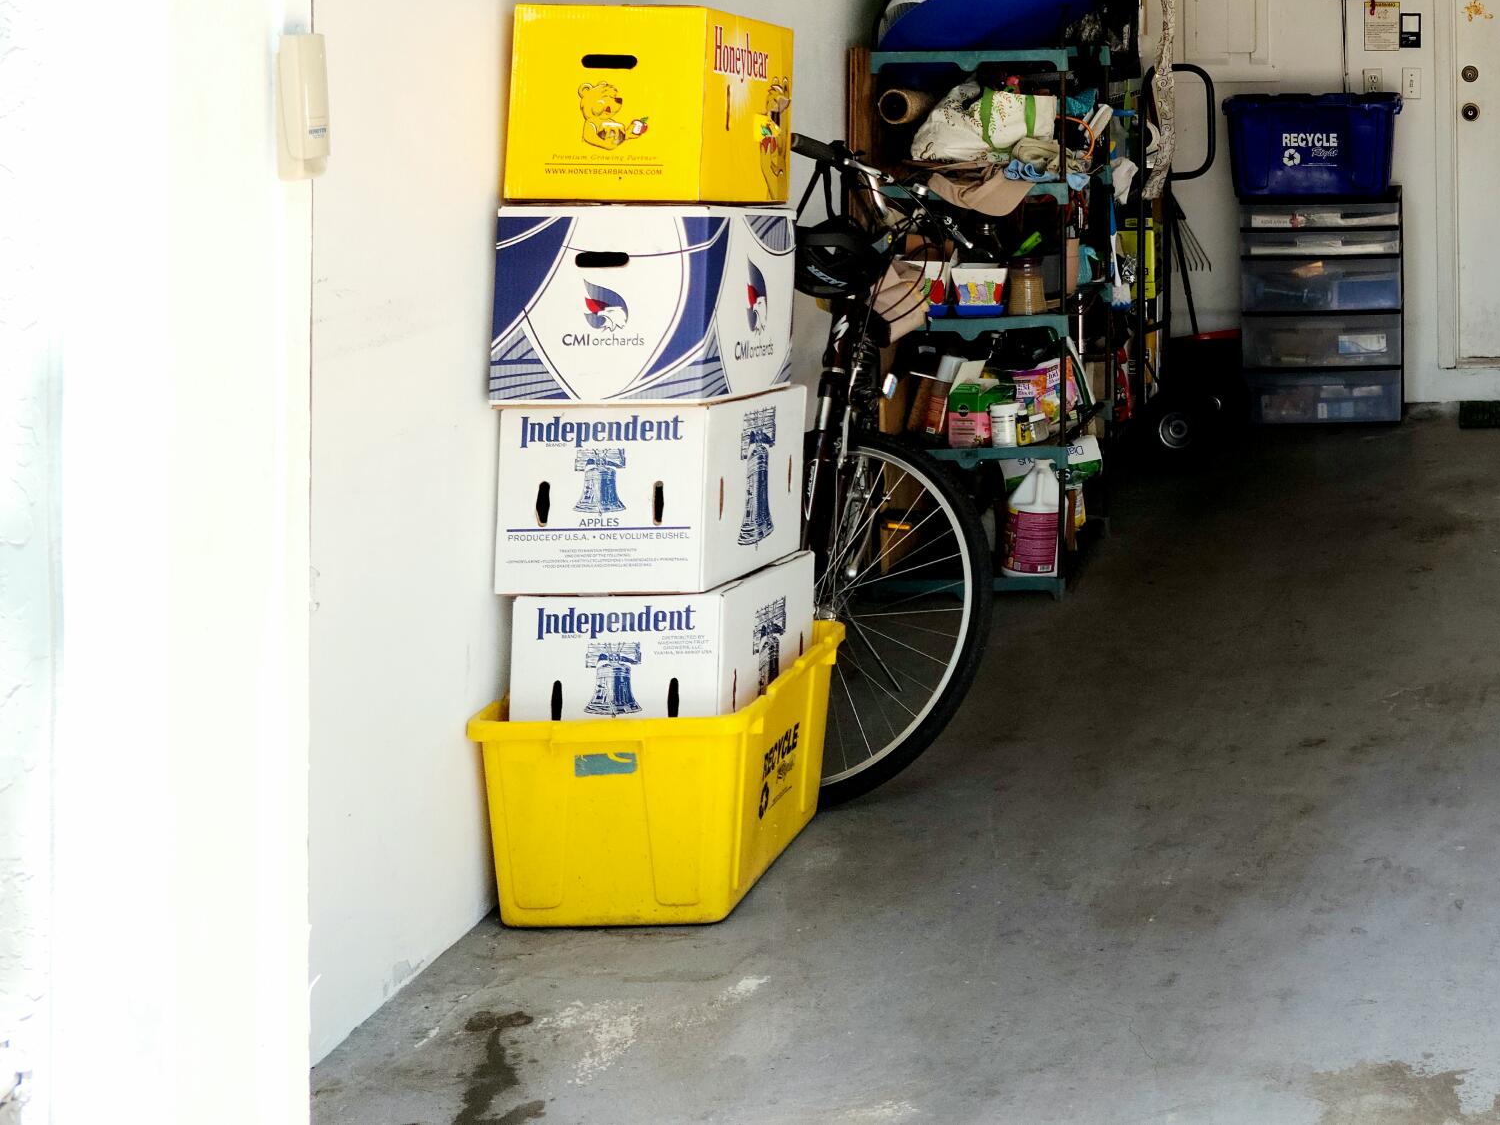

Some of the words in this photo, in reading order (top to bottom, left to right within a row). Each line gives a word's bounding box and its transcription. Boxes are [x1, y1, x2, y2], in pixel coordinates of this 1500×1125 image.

[713, 26, 768, 82] Honeybear
[1282, 134, 1338, 147] RECYCLE
[562, 333, 590, 346] CMI
[592, 334, 644, 346] orchards
[734, 340, 749, 360] CMI
[749, 341, 774, 357] orchards
[520, 415, 685, 448] Independent
[579, 518, 619, 527] APPLES
[565, 533, 589, 541] U.S.A.
[536, 605, 696, 640] Independent
[762, 722, 800, 782] RECYCLE
